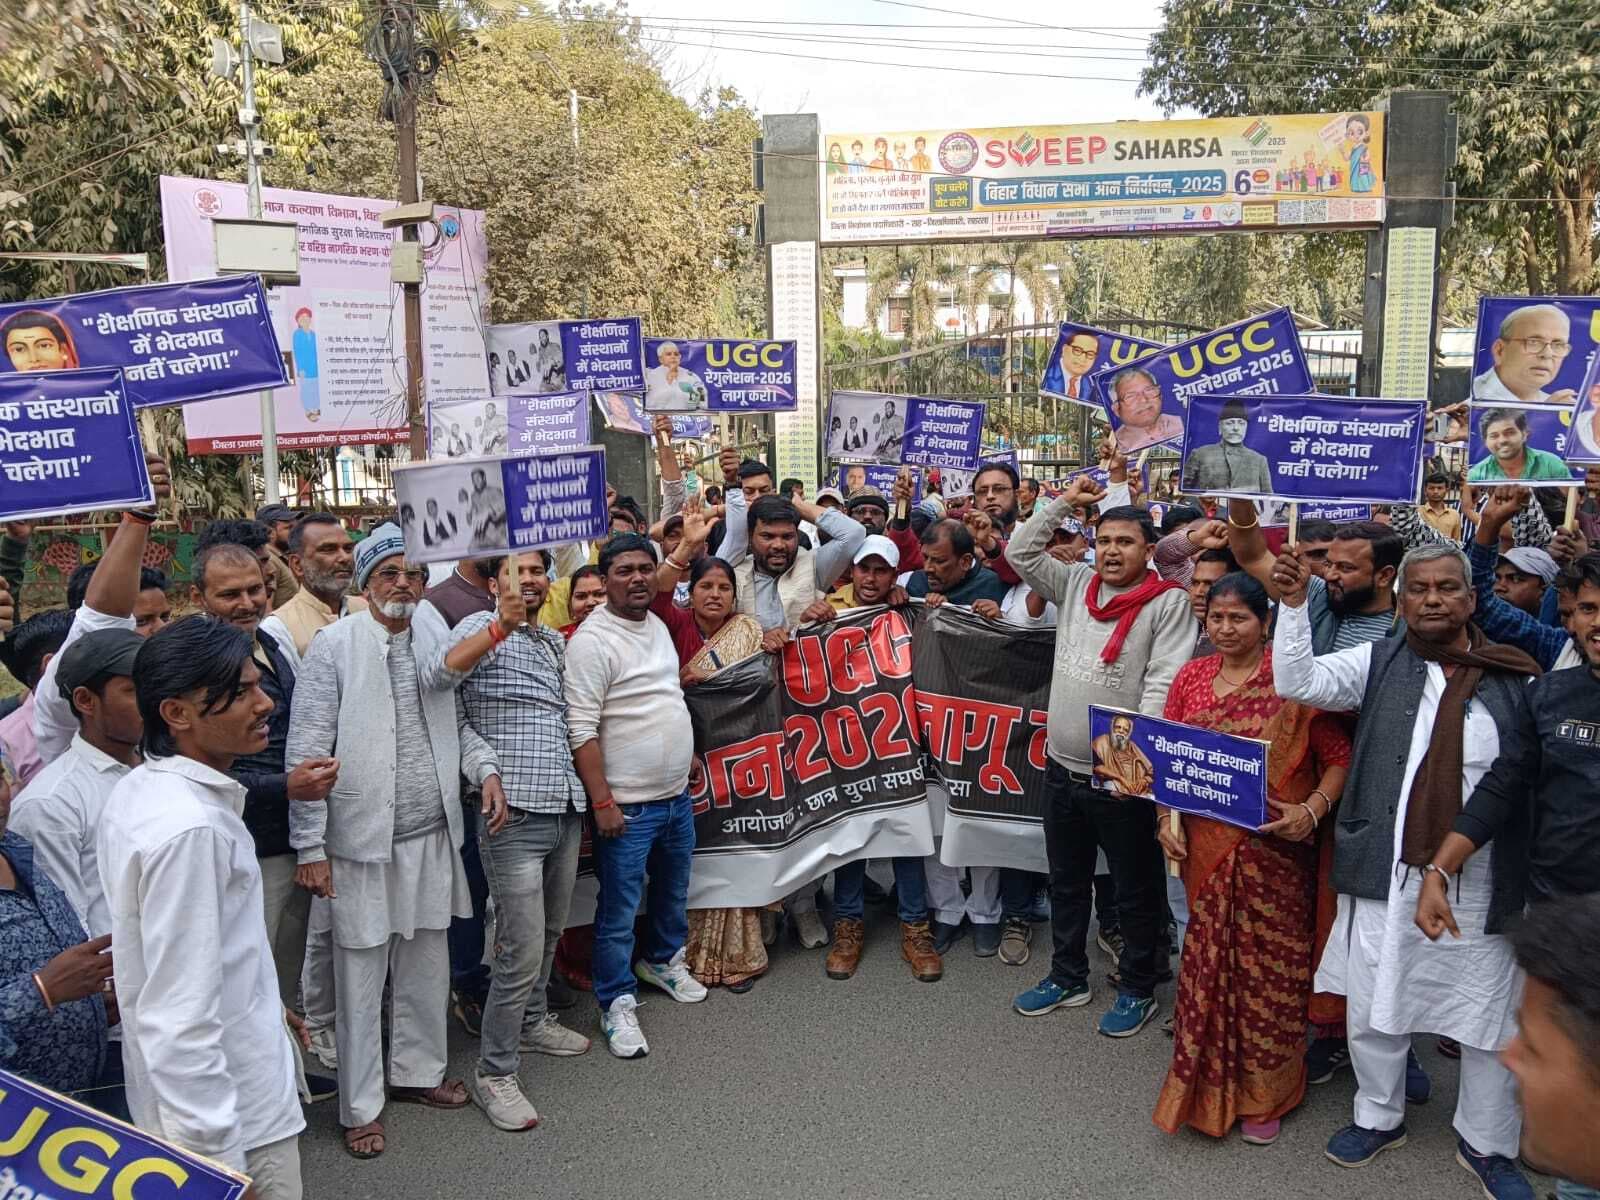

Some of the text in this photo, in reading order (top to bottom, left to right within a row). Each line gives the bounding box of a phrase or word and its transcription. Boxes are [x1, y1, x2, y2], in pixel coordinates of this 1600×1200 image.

[985, 135, 1106, 168] SWEEP
[1114, 137, 1222, 161] SAHARSA
[1268, 136, 1286, 145] 2025
[985, 182, 1018, 200] बिहार
[1021, 181, 1057, 199] विधान
[1062, 181, 1089, 197] सभा
[1094, 181, 1120, 196] आम
[1182, 176, 1222, 192] 2025
[1234, 170, 1251, 195] 6
[288, 203, 324, 217] कल्याण
[299, 222, 329, 236] माजिक
[331, 226, 354, 240] सुरक्षा
[328, 241, 358, 255] नागरिक
[179, 293, 258, 323] संस्थानों
[129, 328, 224, 354] में भेदभाव
[578, 339, 630, 356] संस्थानों
[1168, 320, 1276, 378] UGC
[575, 358, 633, 373] में भेदभाव
[705, 343, 784, 368] UGC
[123, 356, 166, 382] नहीं
[570, 375, 597, 390] नहीं
[23, 389, 120, 420] संस्थानों
[524, 410, 576, 427] संस्थानों
[920, 419, 970, 435] संस्थानों
[1341, 418, 1416, 439] संस्थानों
[520, 428, 577, 442] में भेदभाव
[913, 433, 970, 451] में भेदभाव
[904, 449, 930, 464] नहीं
[1290, 436, 1374, 459] में भेदभाव
[1277, 458, 1315, 477] नहीं
[782, 609, 912, 706] UGC
[1171, 757, 1233, 788] में भेदभाव
[1207, 748, 1262, 777] संस्थानों
[1165, 775, 1191, 795] नहीं
[722, 808, 796, 833] आयोजक
[805, 784, 839, 811] छात्र
[841, 775, 878, 804] युवा
[0, 1089, 190, 1200] UGC
